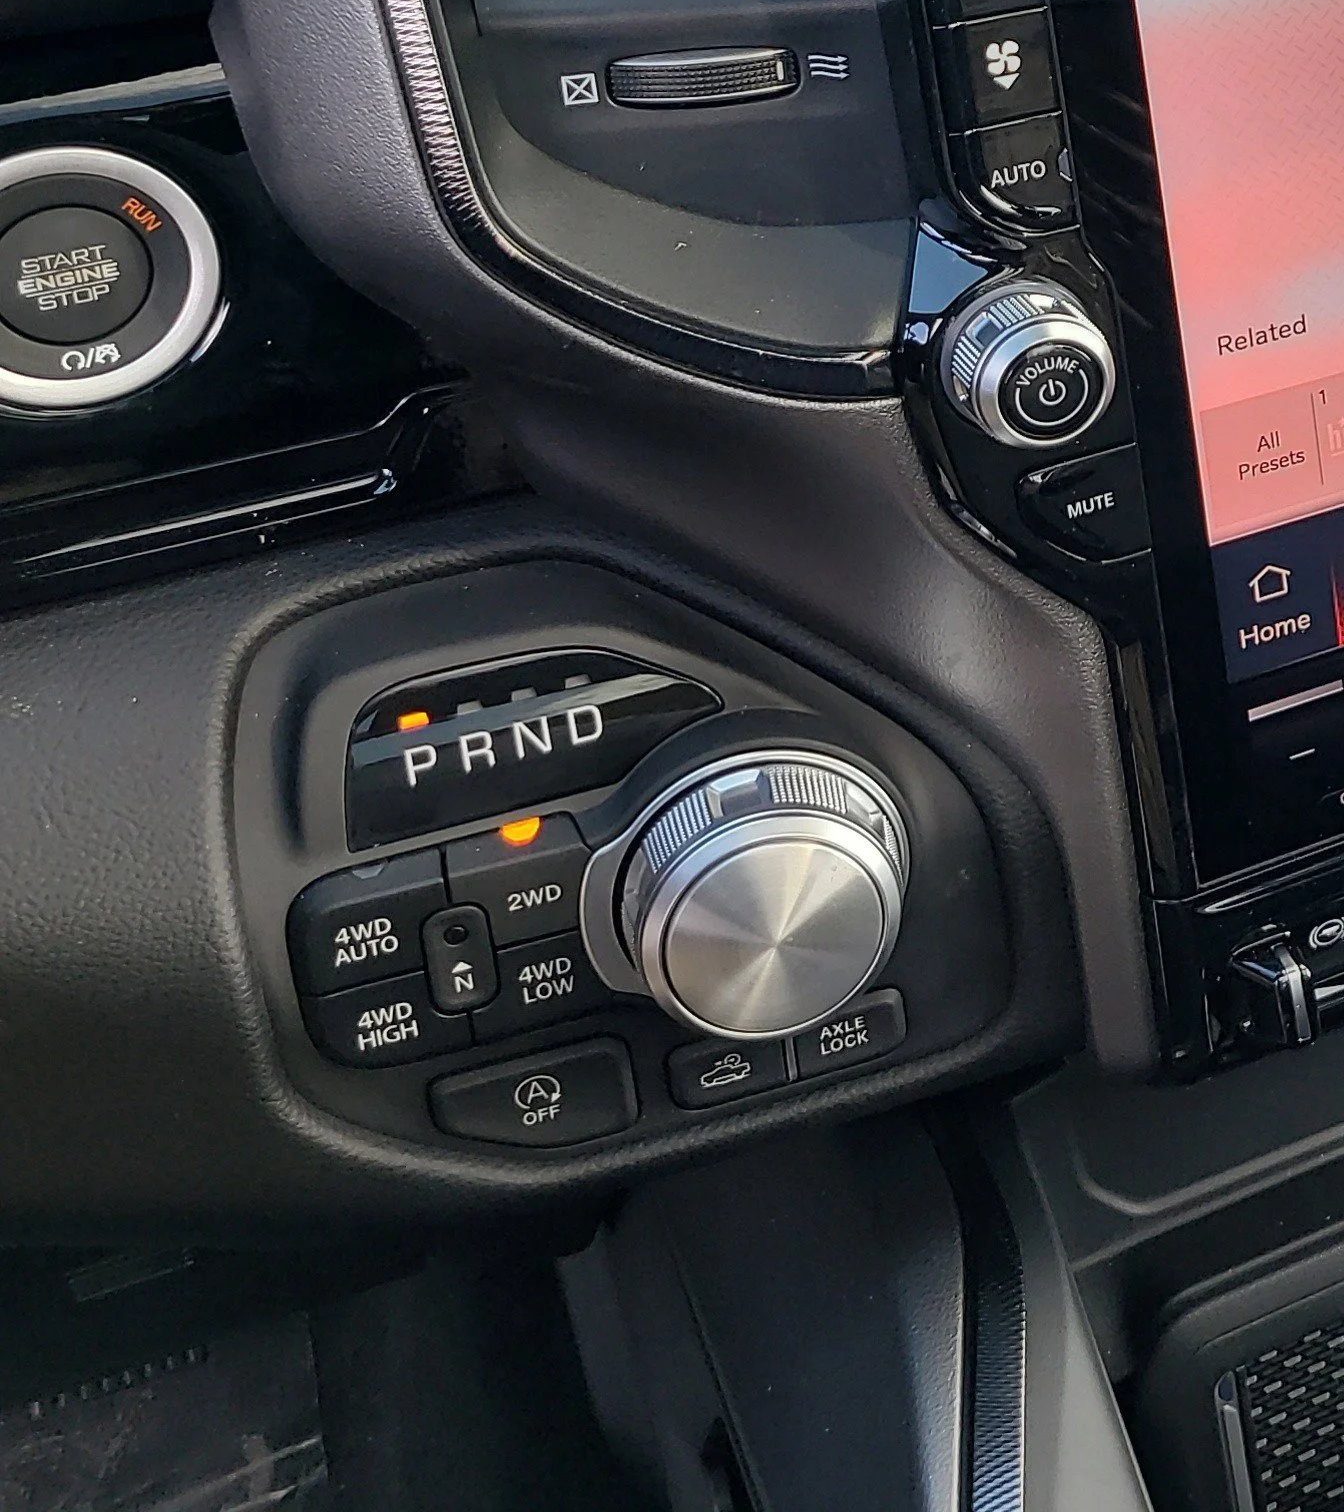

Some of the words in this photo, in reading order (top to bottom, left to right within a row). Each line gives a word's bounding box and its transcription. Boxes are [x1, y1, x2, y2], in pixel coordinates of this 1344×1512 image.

[989, 159, 1047, 188] AUTO
[121, 196, 163, 233] RUN
[20, 244, 107, 274] START
[17, 262, 121, 296] ENGINE
[37, 284, 111, 312] STOP
[1216, 314, 1308, 356] Related
[1015, 355, 1080, 389] VOLUME
[1318, 389, 1328, 406] 1
[1256, 430, 1281, 454] All
[1237, 449, 1307, 481] Presets
[1066, 491, 1116, 520] MUTE
[1238, 611, 1312, 649] Home
[507, 884, 563, 913] 2WD
[333, 916, 393, 945] 4WD
[334, 934, 400, 967] AUTO
[454, 971, 475, 994] N
[517, 957, 573, 985] 4WD
[521, 974, 576, 1006] LOW
[356, 1002, 414, 1030] 4WD
[818, 1015, 866, 1040] AXLE
[356, 1019, 420, 1052] HIGH
[819, 1029, 869, 1055] LOCK
[521, 1103, 563, 1127] OFF
